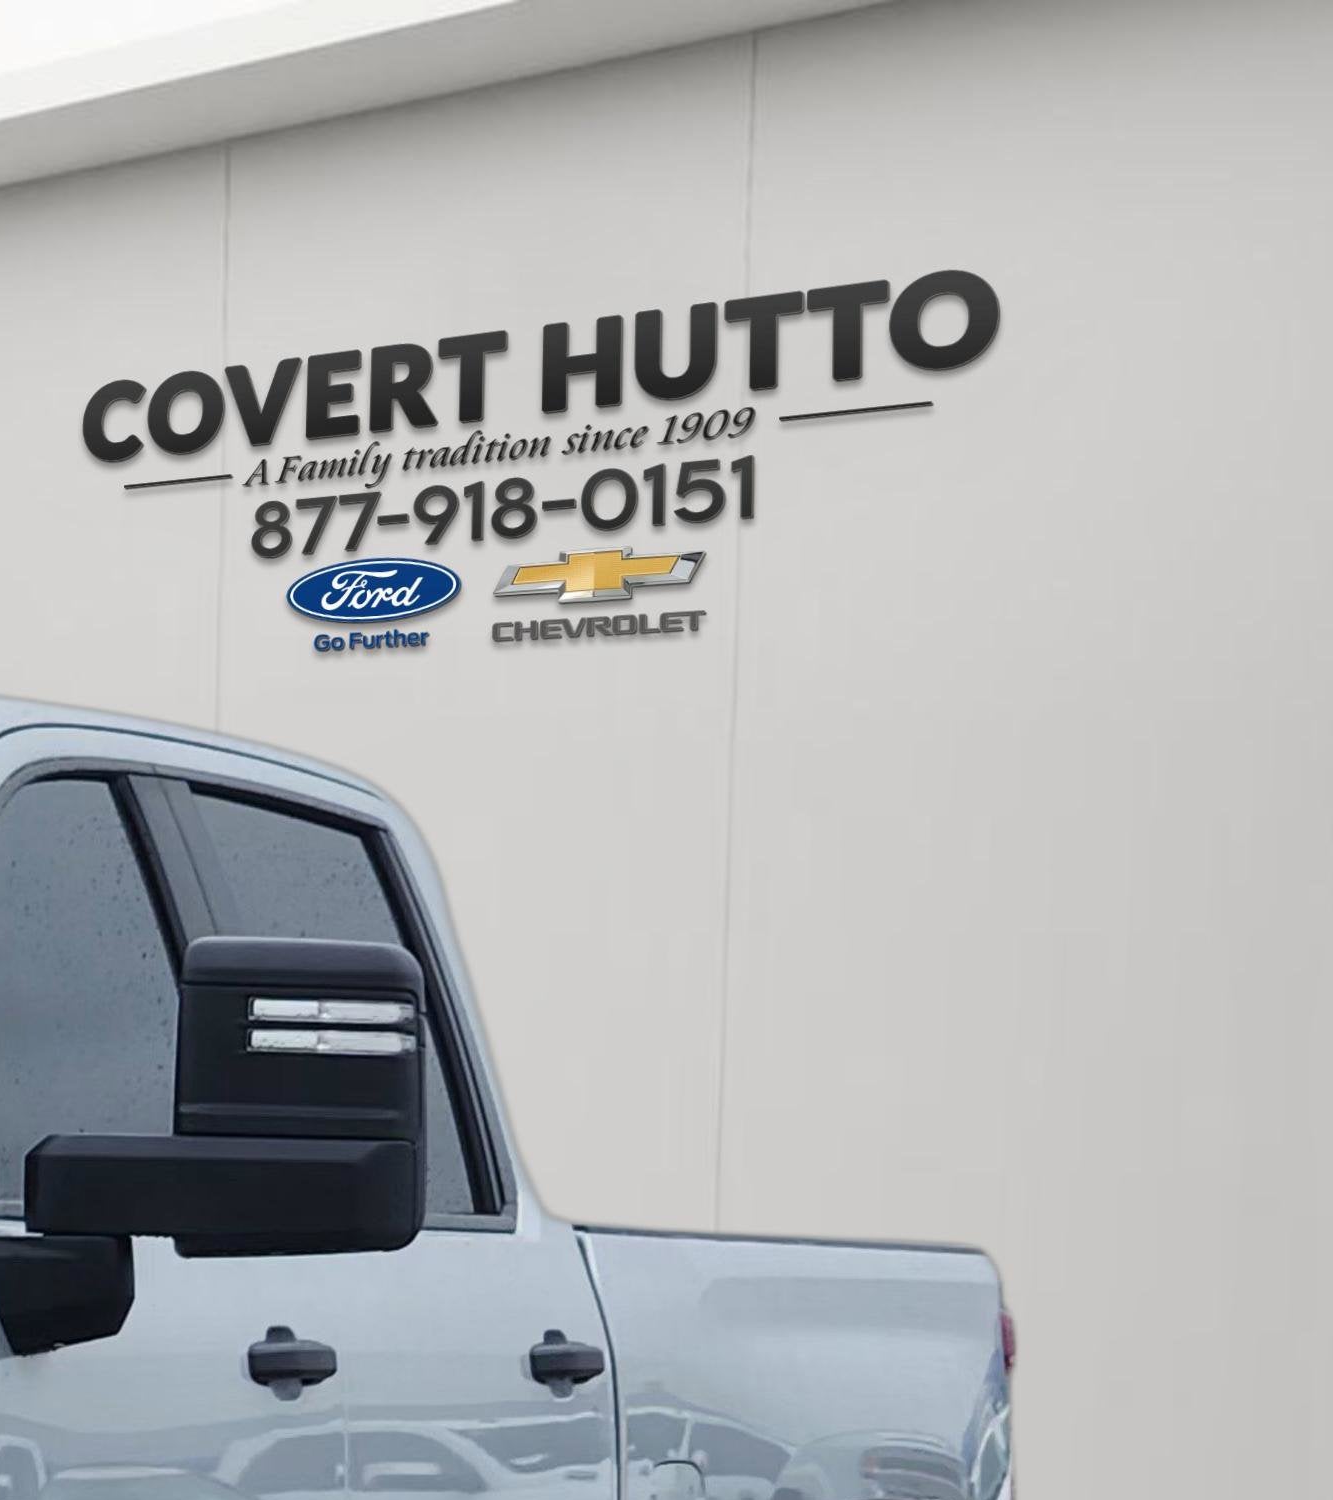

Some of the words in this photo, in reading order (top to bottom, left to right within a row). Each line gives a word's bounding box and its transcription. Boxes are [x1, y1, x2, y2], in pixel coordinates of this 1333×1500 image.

[82, 330, 508, 464] COVERT
[540, 268, 1001, 416] HUTTO
[243, 458, 269, 488] A
[276, 441, 394, 488] Family
[401, 430, 551, 472] tradition
[560, 422, 649, 456] since
[655, 407, 757, 446] 1909
[250, 454, 757, 559] 877-918-0151
[320, 569, 423, 610] Ford
[313, 631, 346, 653] Go
[349, 628, 431, 652] Further
[491, 609, 707, 644] CHEVROLET
